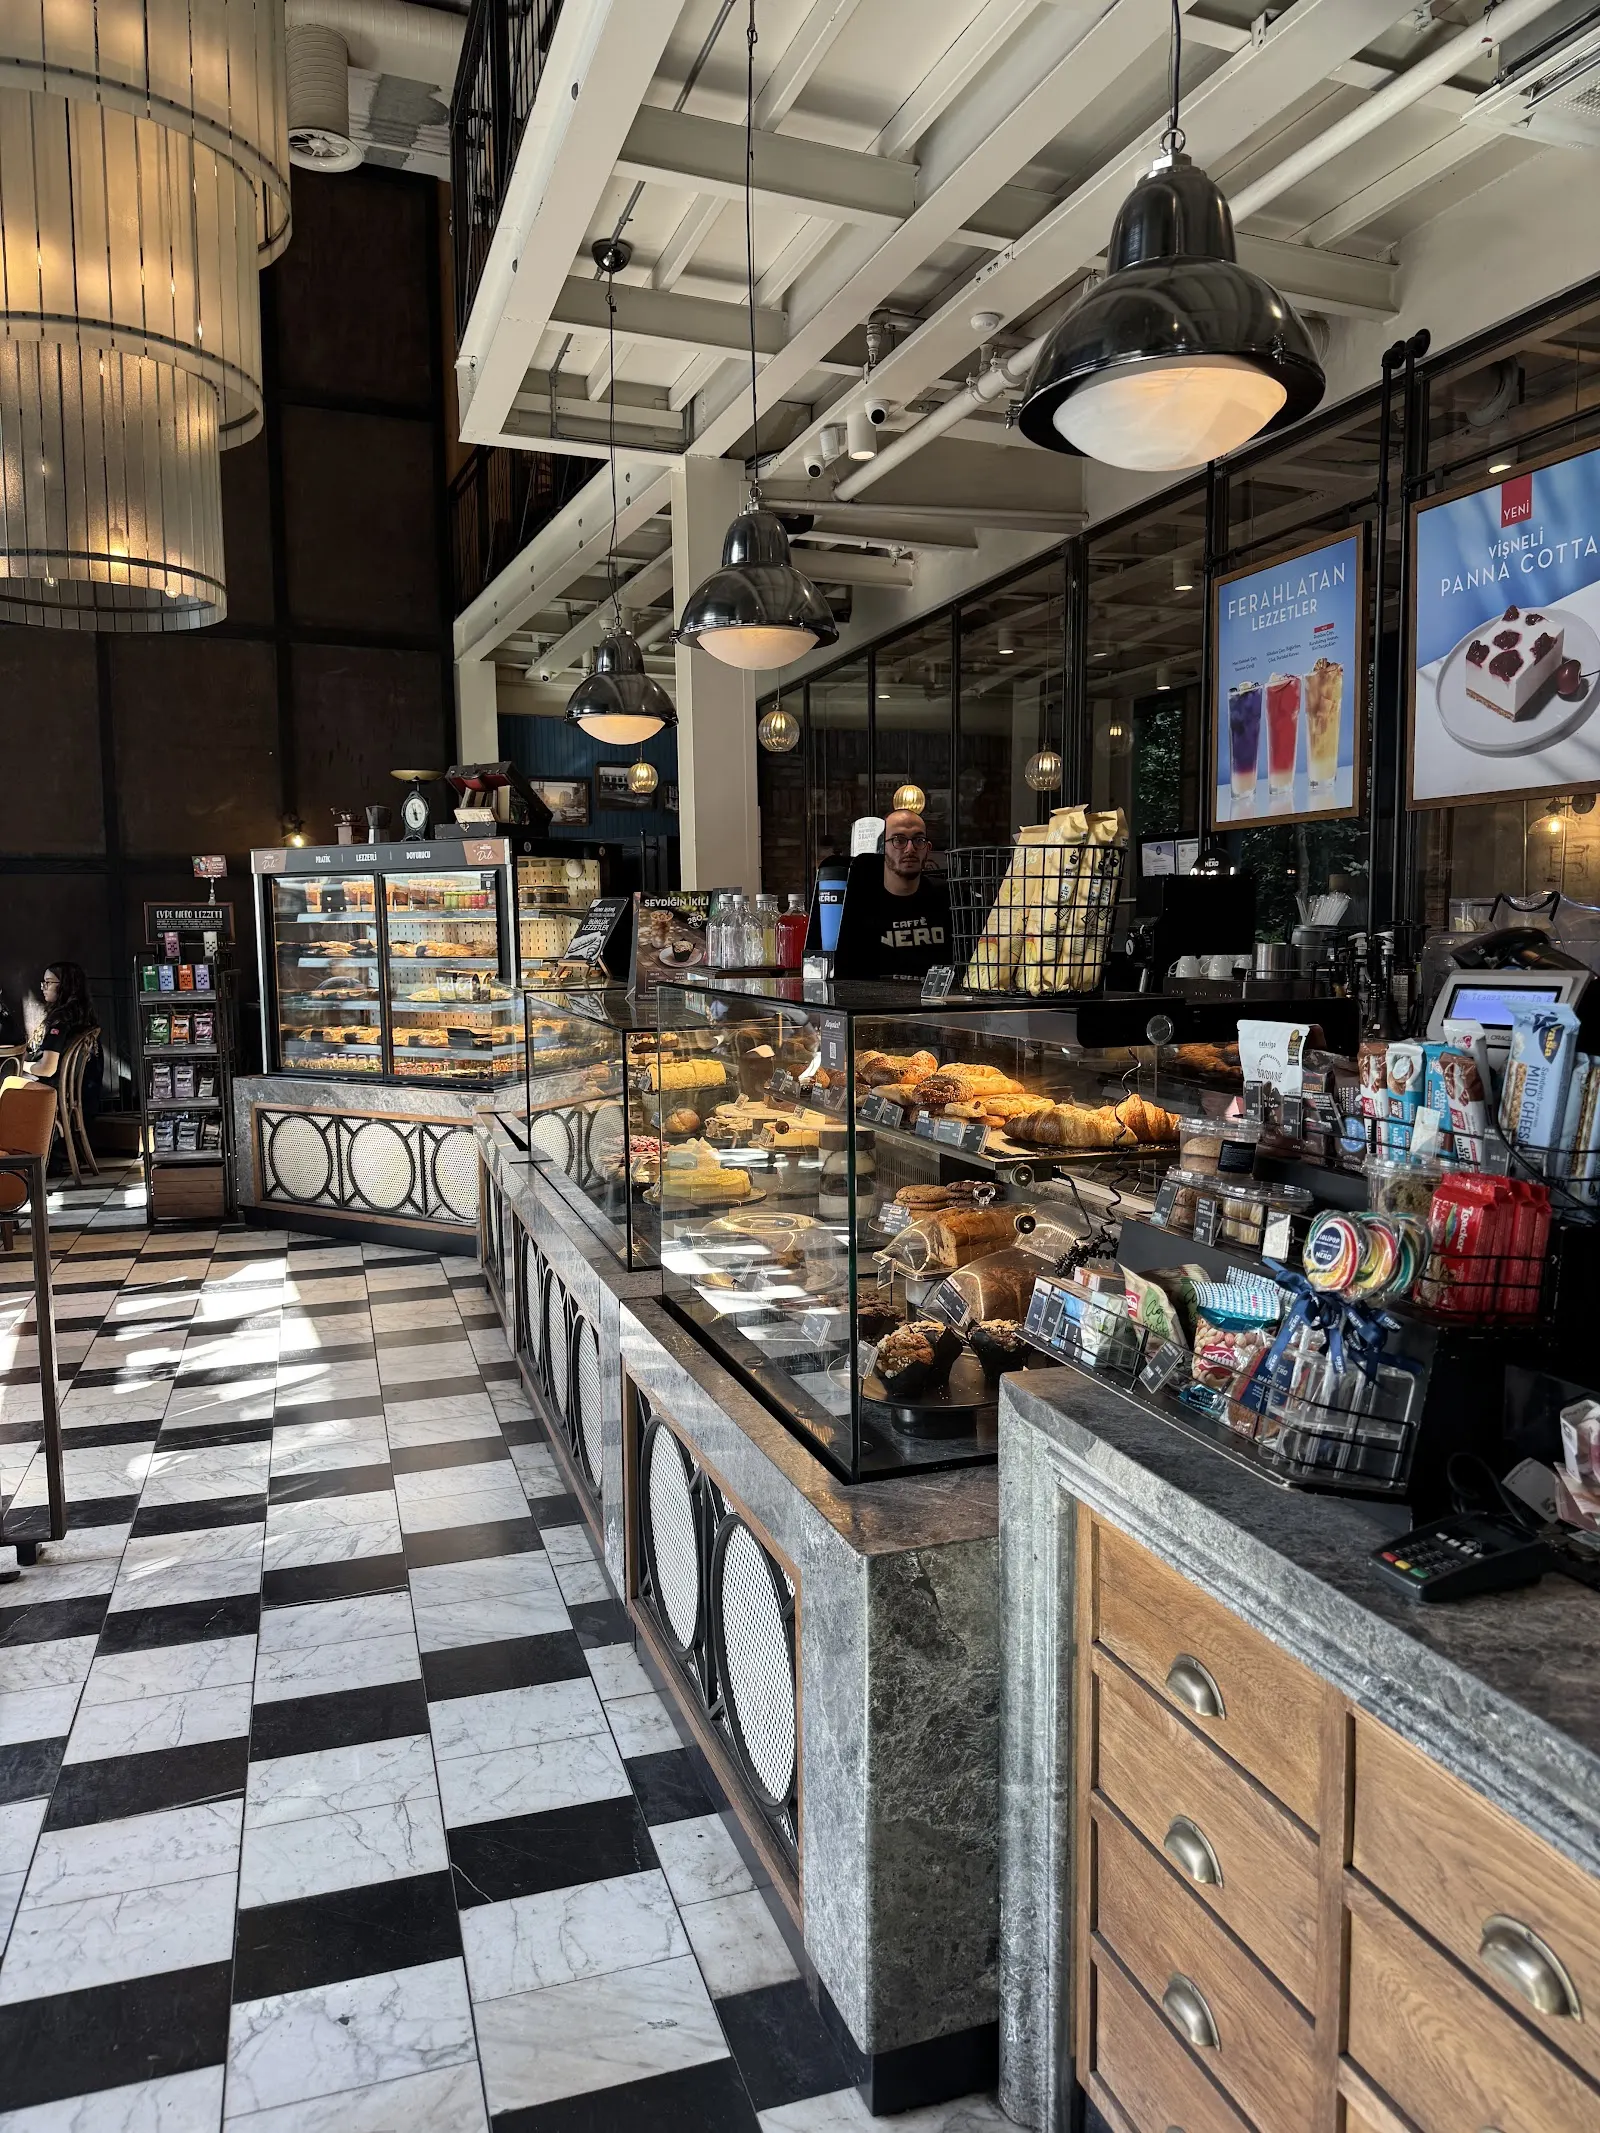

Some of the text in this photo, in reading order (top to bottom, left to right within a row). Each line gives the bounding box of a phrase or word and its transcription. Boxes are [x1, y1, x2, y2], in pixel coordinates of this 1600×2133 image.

[1503, 499, 1530, 520] YENİ
[1488, 526, 1544, 560] VİŞNELİ
[1441, 535, 1598, 597] PANNA COTTA
[1228, 562, 1345, 620] FERAHLATAN
[1251, 598, 1317, 631] LEZZETLER
[315, 850, 431, 864] PRATİK LEZZETLİ DOYURUCU
[1204, 860, 1219, 868] NERO
[644, 895, 709, 907] SEVDİĞİN İKİLİ
[175, 910, 193, 919] NERO
[194, 908, 223, 919] LEZZETİ
[892, 916, 928, 929] CAFFÈ
[581, 924, 610, 932] LEZZETLER
[1490, 1034, 1513, 1042] ORACL
[1524, 1065, 1541, 1097] MILD
[1536, 1066, 1549, 1102] Sandwich
[1438, 1080, 1447, 1119] protein
[1315, 1251, 1332, 1261] NERO
[1288, 1314, 1301, 1333] NERO
